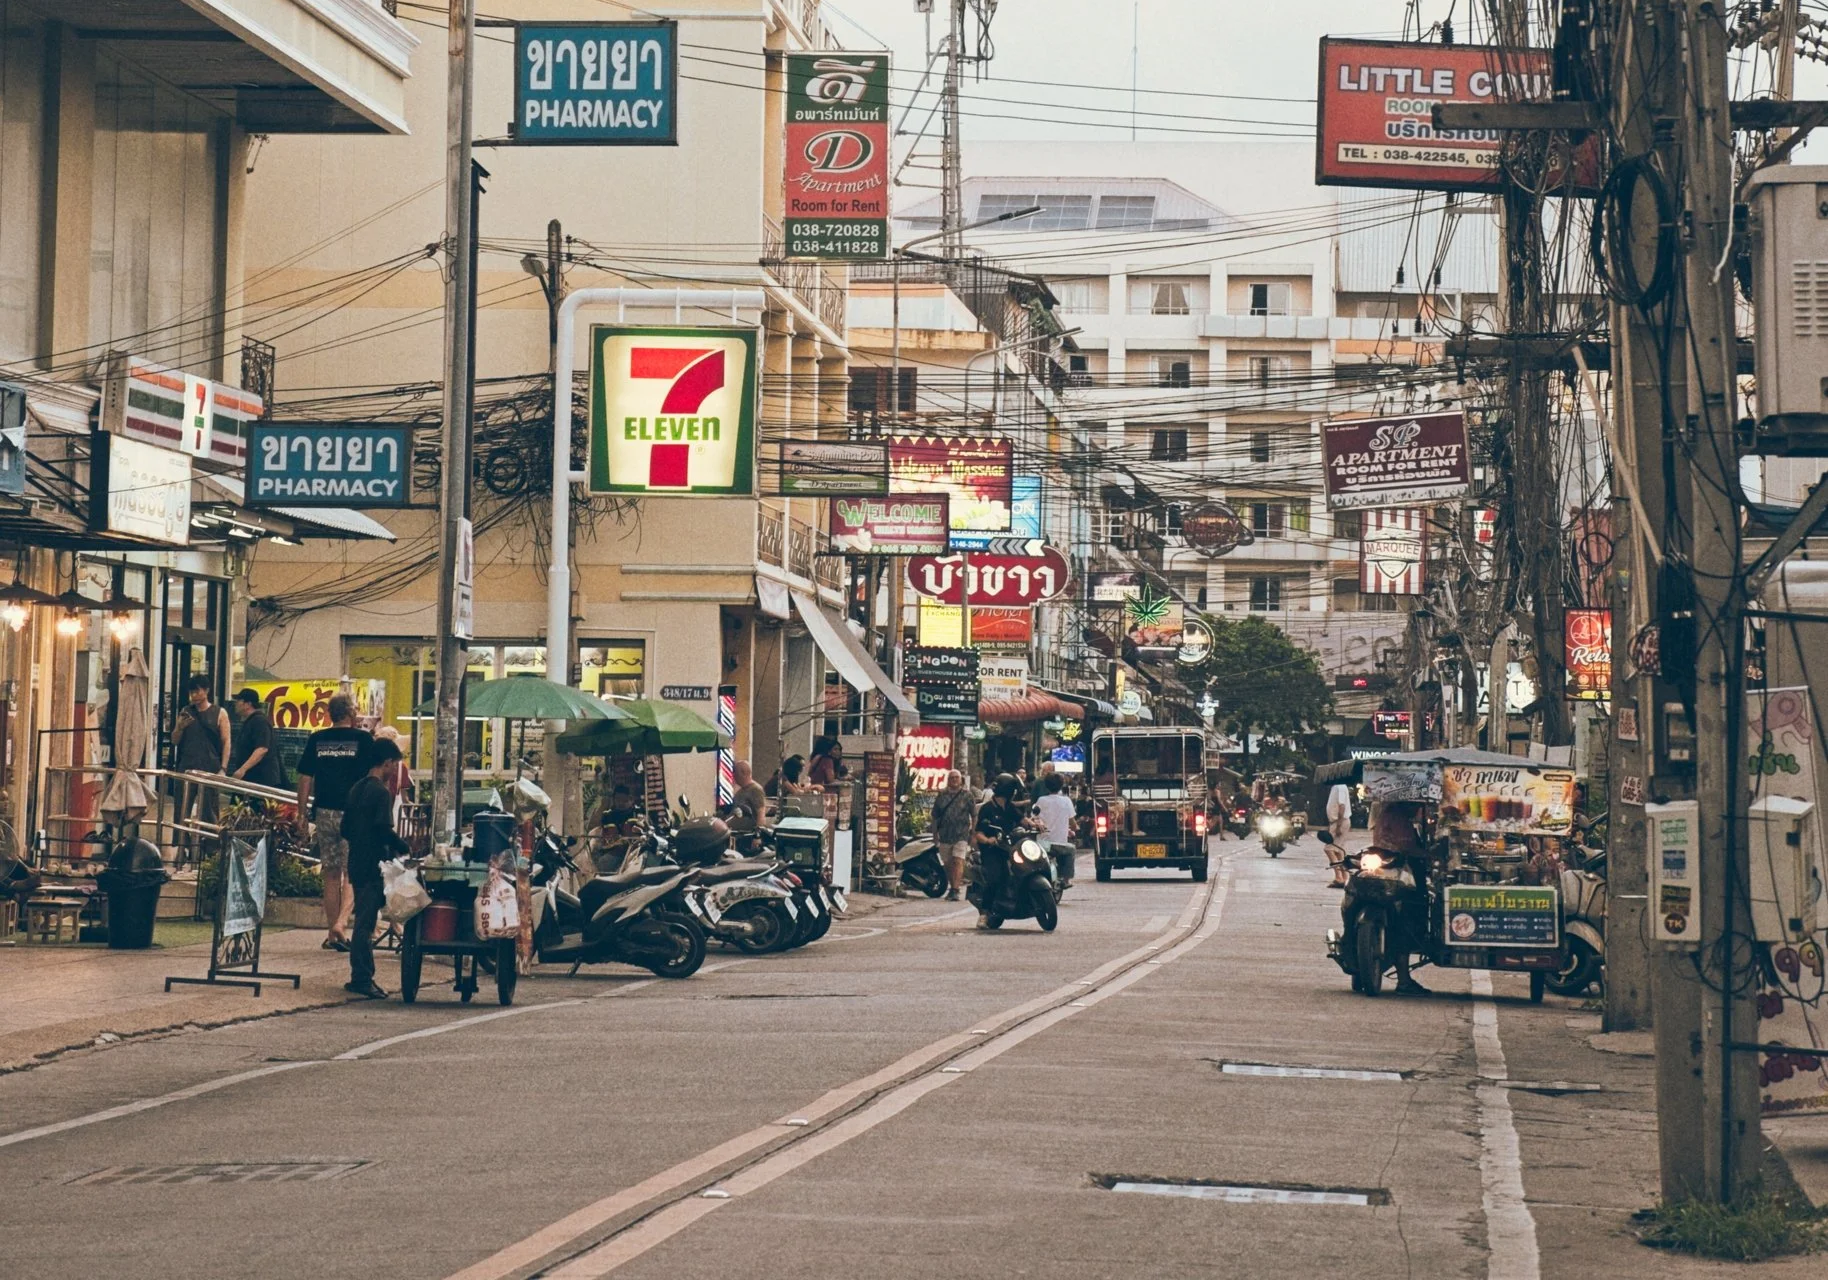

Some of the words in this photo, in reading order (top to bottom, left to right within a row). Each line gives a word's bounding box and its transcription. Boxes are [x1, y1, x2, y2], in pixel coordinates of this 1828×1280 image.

[527, 39, 662, 90] ขายยา
[805, 59, 877, 104] ดี
[1340, 66, 1454, 95] LITTLE
[1469, 71, 1552, 100] COU
[526, 99, 663, 129] PHARMACY
[804, 129, 874, 173] D
[1343, 148, 1368, 159] TEL
[1383, 150, 1470, 165] 038-422545,
[789, 172, 883, 193] Apartment
[791, 199, 827, 212] Room
[831, 198, 848, 212] for
[851, 199, 880, 212] Rent
[792, 224, 879, 237] 038-720828
[792, 241, 879, 253] 038-411828
[630, 347, 725, 486] 7
[261, 435, 398, 472] ขายยา
[1331, 444, 1462, 466] APARTMENT
[1336, 464, 1384, 475] ROOM
[1387, 461, 1417, 471] FOR
[1420, 458, 1458, 468] RENT
[258, 477, 399, 497] PHARMACY
[837, 498, 942, 527] WELCOME
[1366, 541, 1420, 555] MARQUEE
[921, 554, 1055, 597] บัวขาว
[926, 610, 962, 618] EXCHANG
[1571, 646, 1610, 666] Rela
[980, 667, 994, 676] OR
[997, 668, 1024, 677] RENT
